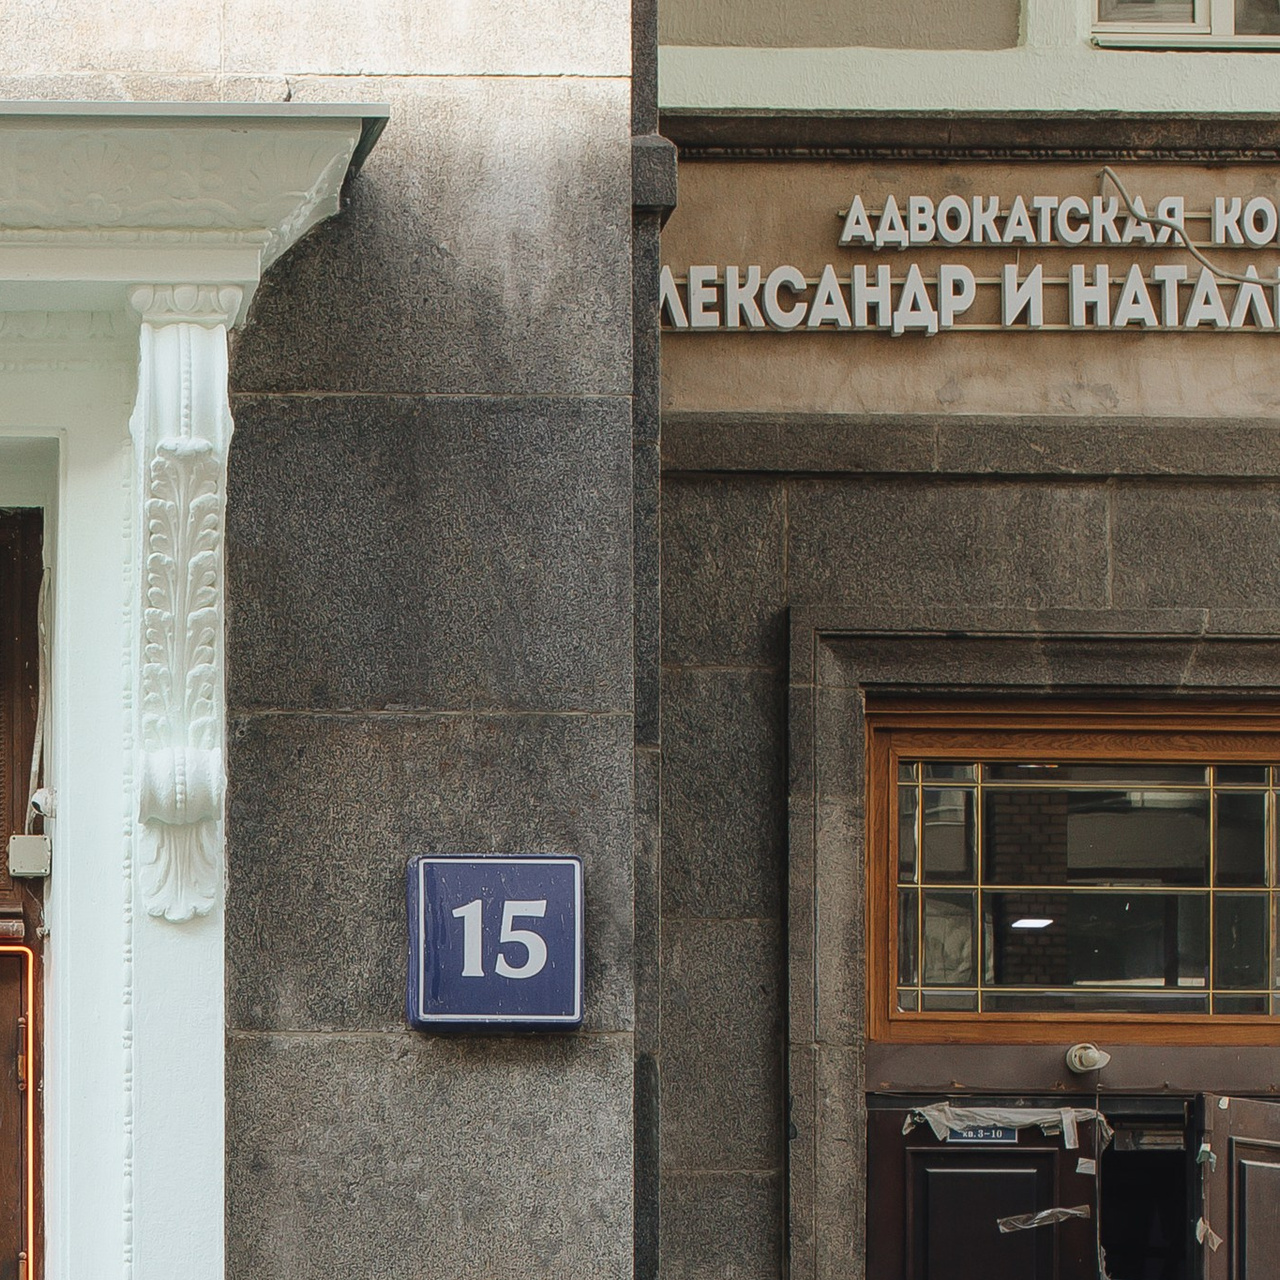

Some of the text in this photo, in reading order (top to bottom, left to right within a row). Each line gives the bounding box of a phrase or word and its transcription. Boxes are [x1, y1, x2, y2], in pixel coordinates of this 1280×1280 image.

[841, 194, 1185, 250] АДВОКАТСКАЯ
[1006, 264, 1044, 328] И
[1072, 263, 1280, 329] НАТАЛ
[451, 899, 548, 979] 15
